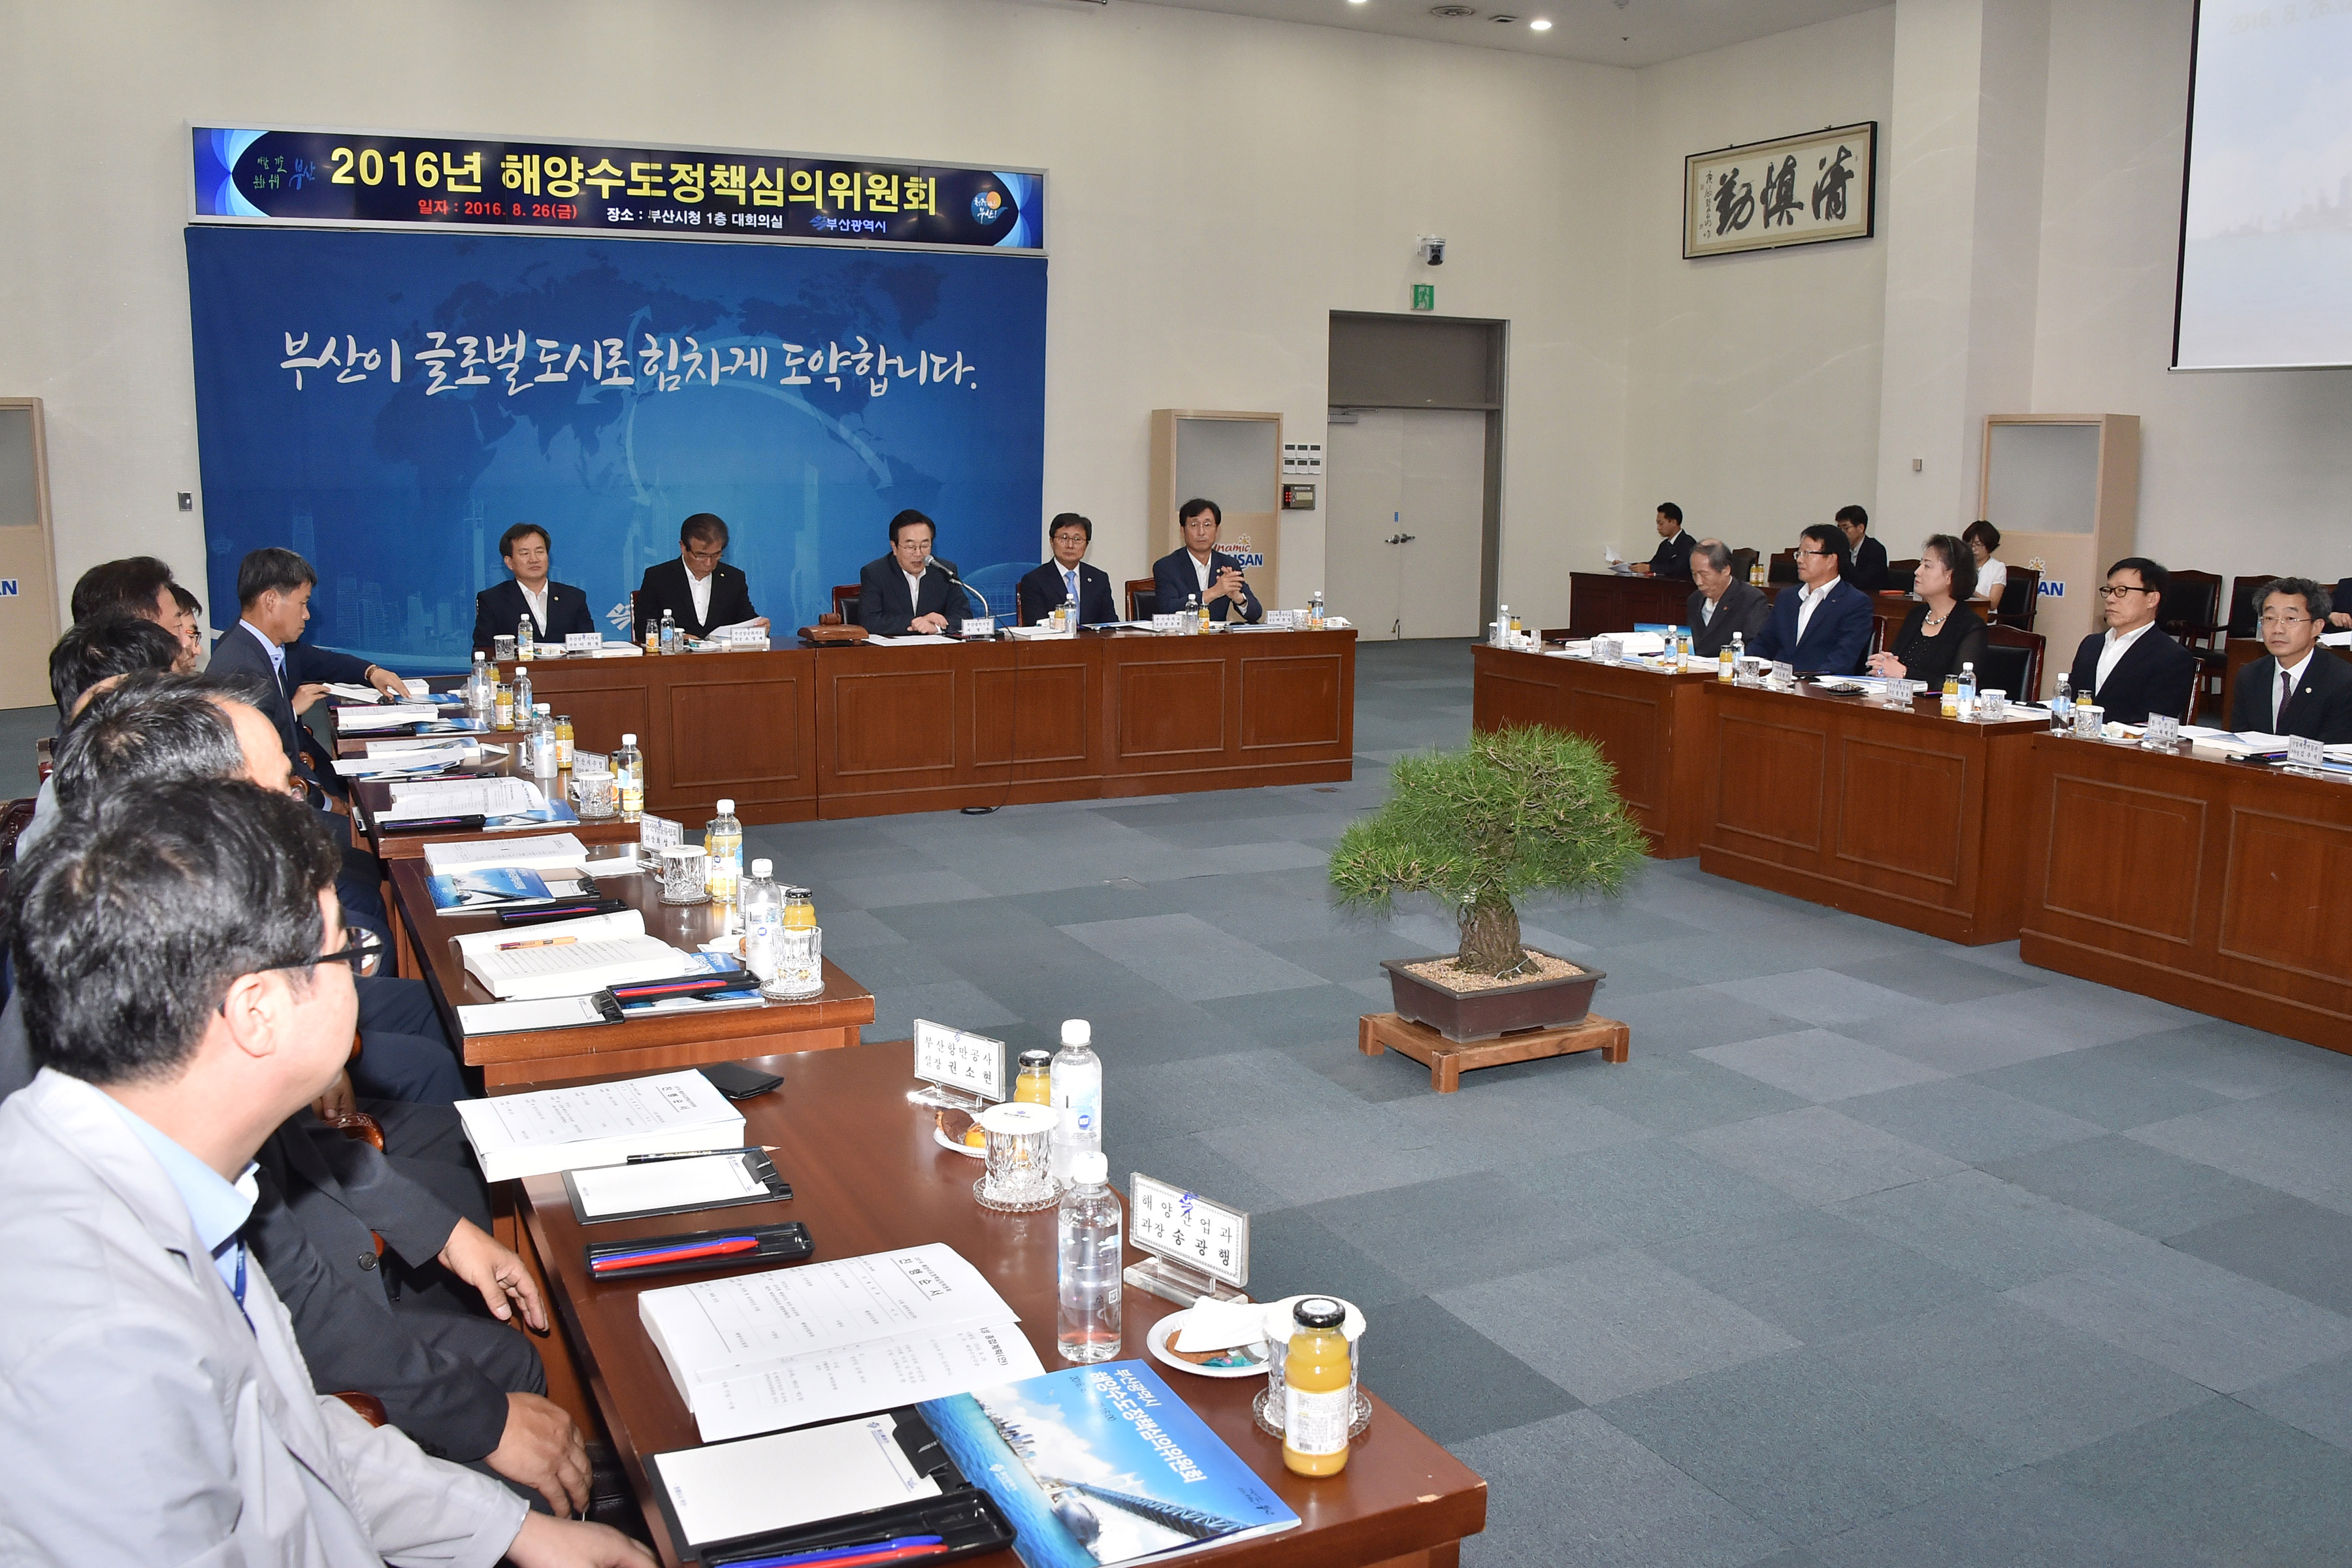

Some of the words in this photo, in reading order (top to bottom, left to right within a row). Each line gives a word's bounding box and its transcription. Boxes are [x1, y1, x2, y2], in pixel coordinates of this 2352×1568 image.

[331, 148, 482, 193] 2016년
[500, 154, 936, 216] 해양수도정책심의위원회
[418, 199, 449, 216] 일자
[465, 201, 506, 216] 2016.
[512, 203, 527, 217] 8.
[532, 204, 578, 220] 26(금)
[606, 207, 634, 222] 장소
[648, 208, 702, 225] 부산시청
[706, 212, 728, 227] 1층
[731, 213, 784, 229] 대회의실
[826, 216, 887, 234] 부산광역시
[280, 331, 400, 391] 부산이
[415, 329, 534, 396] 글로벌
[534, 338, 635, 385] 도시로
[779, 335, 977, 397] 도약합니다.
[1213, 544, 1252, 553] namic
[1228, 553, 1264, 566] SAN
[925, 1036, 992, 1066] 부산항만공사
[925, 1055, 941, 1070] 실장
[1141, 1217, 1165, 1238] 과장
[1114, 1369, 1162, 1407] 부산광역시
[1089, 1370, 1208, 1484] 해양수도정책심의위원회
